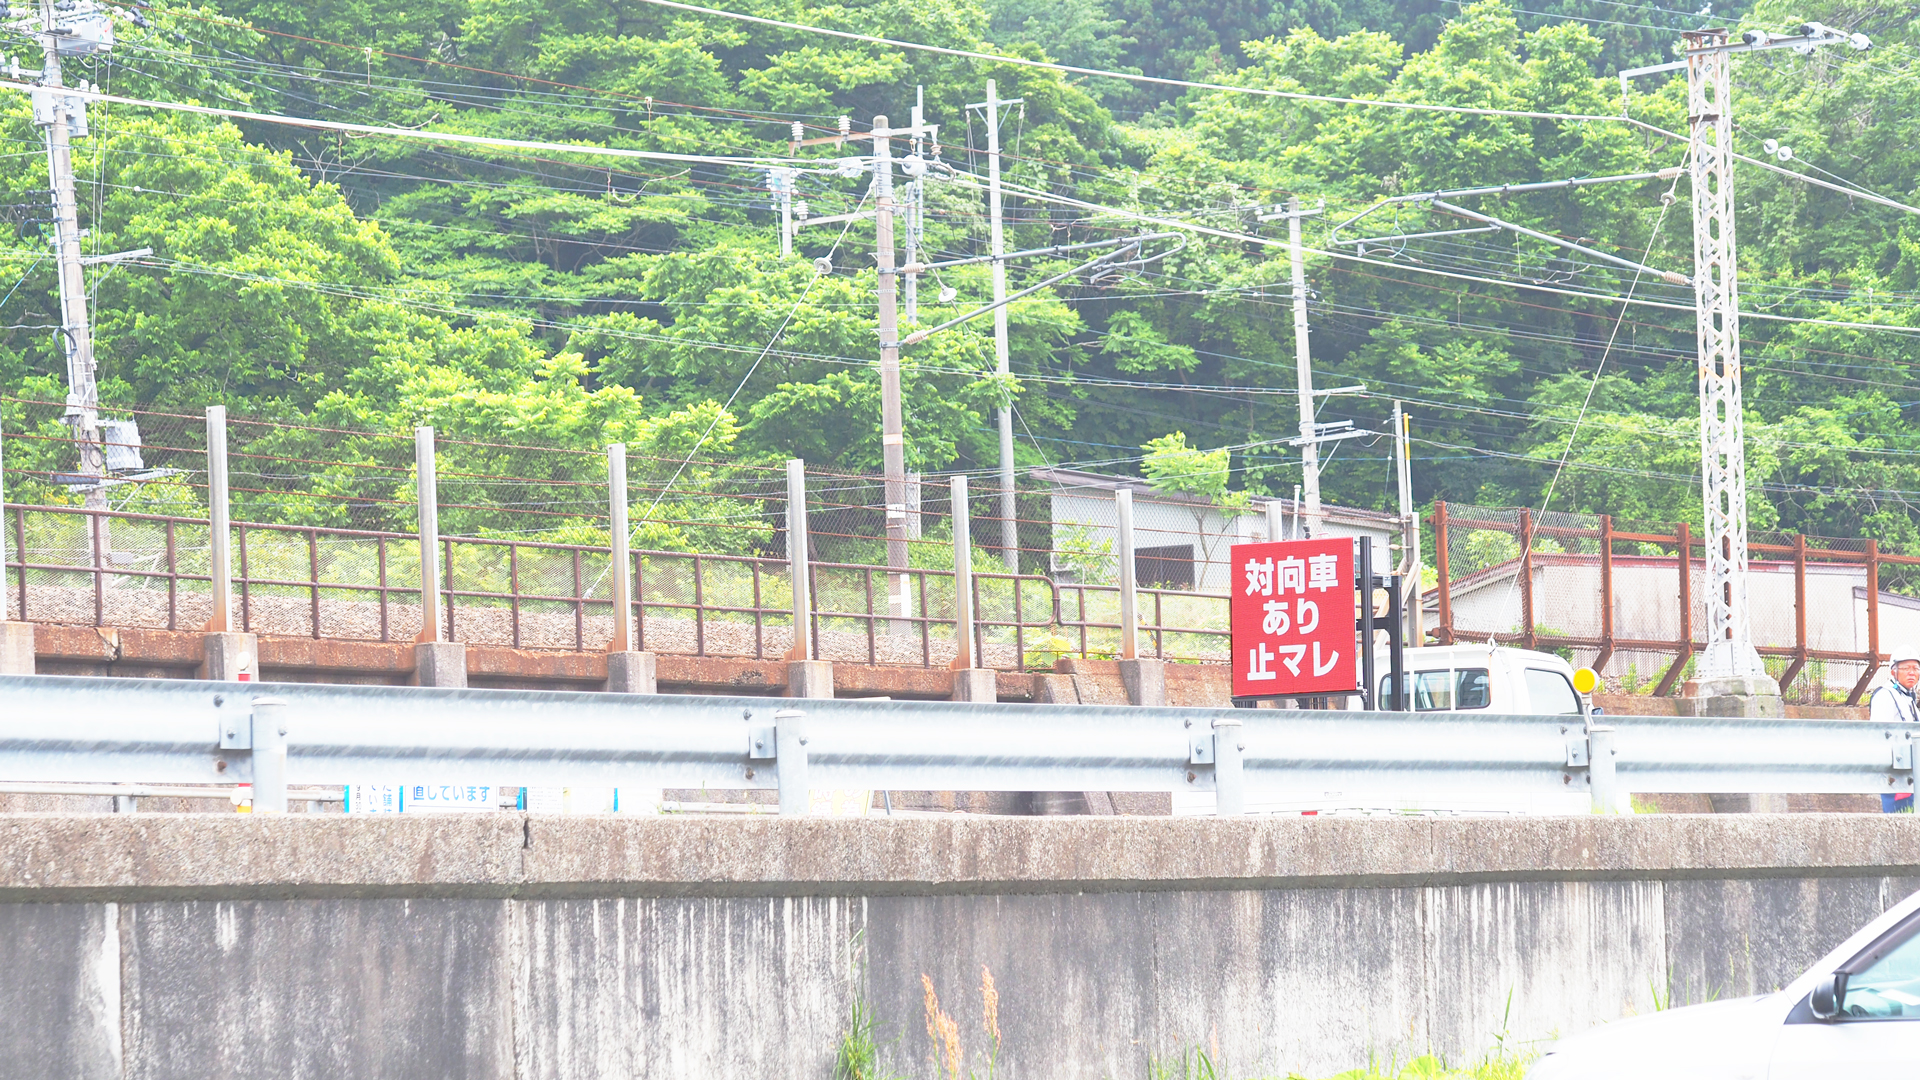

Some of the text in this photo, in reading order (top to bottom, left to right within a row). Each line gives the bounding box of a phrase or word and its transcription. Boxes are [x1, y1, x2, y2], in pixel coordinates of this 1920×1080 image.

[1244, 553, 1339, 596] 対向車
[1262, 598, 1320, 636] あり
[1247, 641, 1340, 681] 止マレ
[413, 786, 490, 802] 直しています
